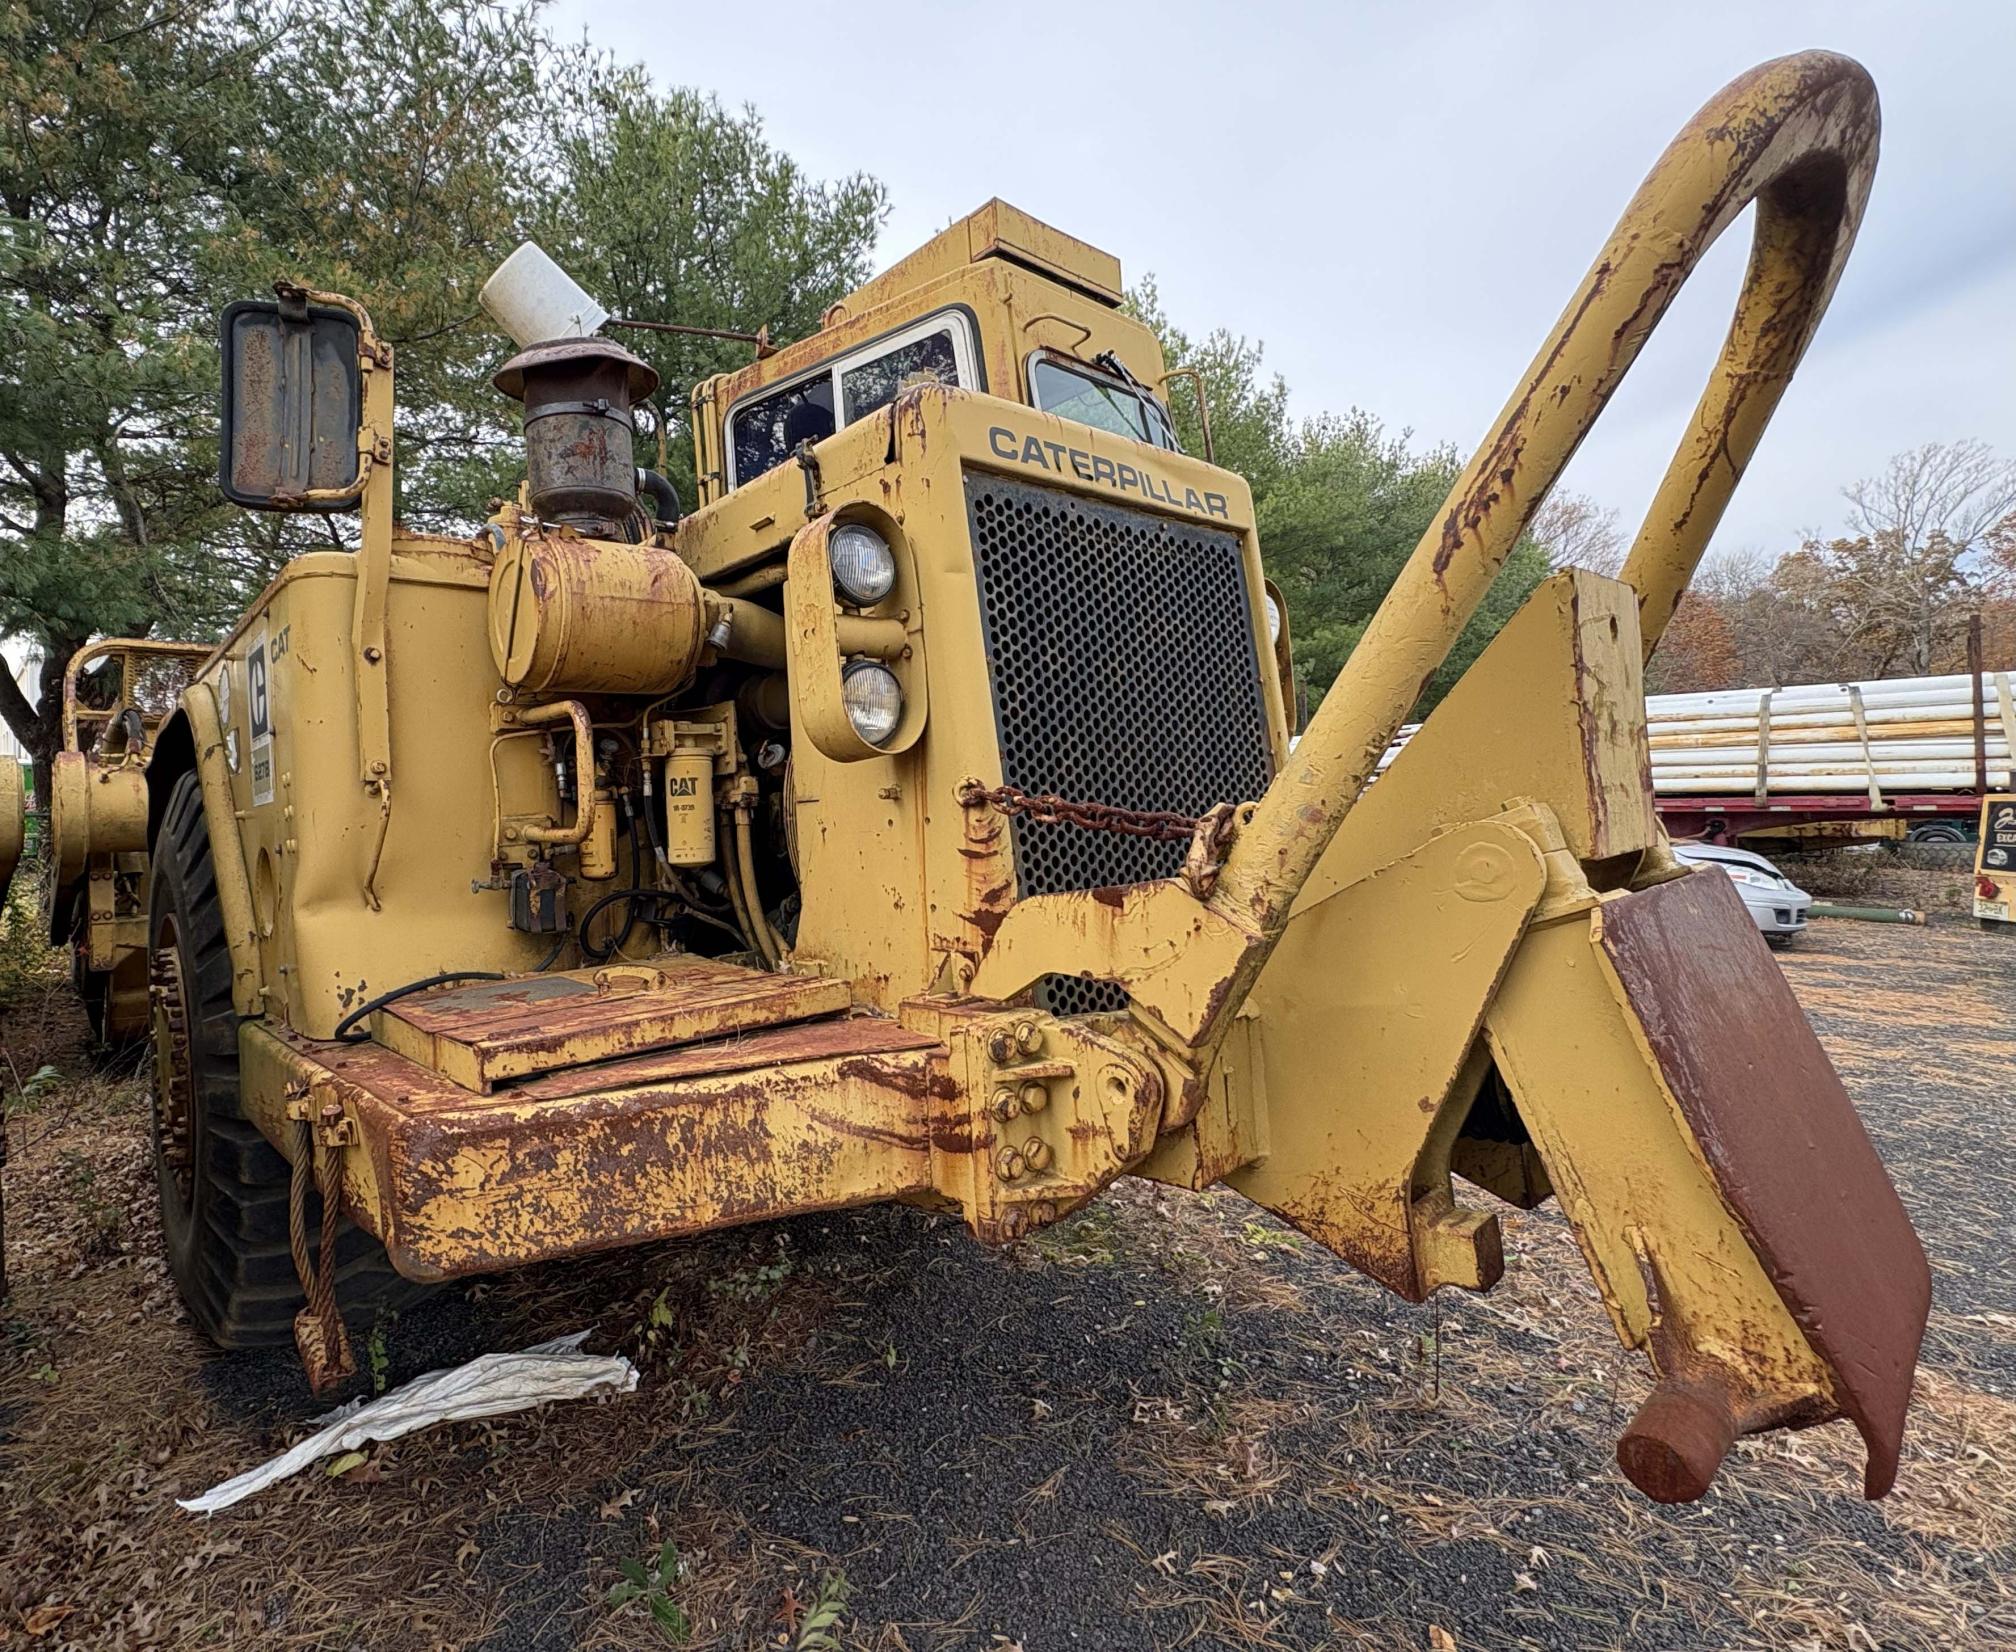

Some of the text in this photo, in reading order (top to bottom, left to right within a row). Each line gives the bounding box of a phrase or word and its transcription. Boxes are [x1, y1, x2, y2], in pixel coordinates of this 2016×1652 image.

[989, 426, 1228, 519] CATERPILLAR
[271, 625, 291, 664] CAT
[670, 777, 698, 797] CAT
